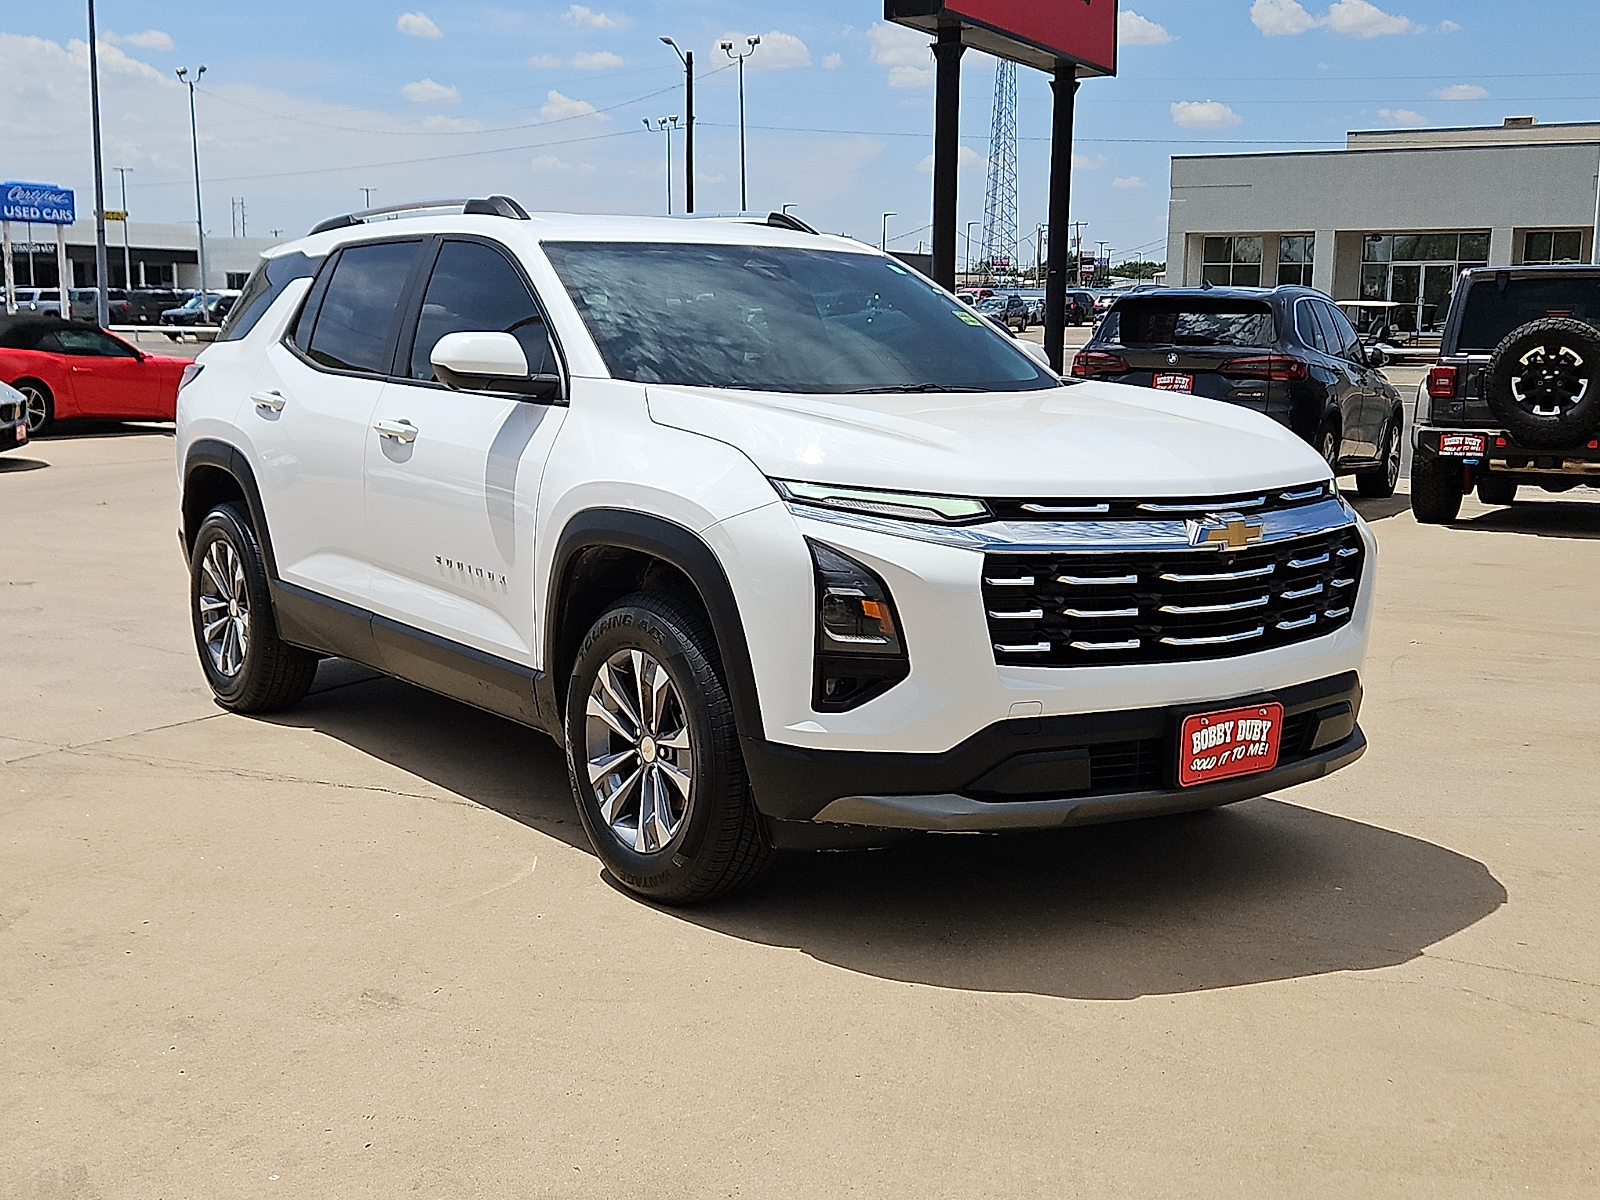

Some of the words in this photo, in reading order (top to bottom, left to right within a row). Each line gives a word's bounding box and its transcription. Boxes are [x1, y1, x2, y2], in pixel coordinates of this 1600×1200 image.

[7, 185, 69, 206] Certified
[4, 205, 40, 218] USED
[42, 208, 73, 220] CARS
[578, 613, 634, 662] TOURING
[637, 618, 667, 647] A/S
[1191, 720, 1235, 755] BOBBY
[1236, 719, 1272, 742] DUBY
[1190, 756, 1217, 771] SOLD
[1217, 750, 1231, 767] IT
[1231, 745, 1246, 762] TO
[1246, 741, 1269, 757] ME!
[619, 868, 673, 888] VANTAGE
